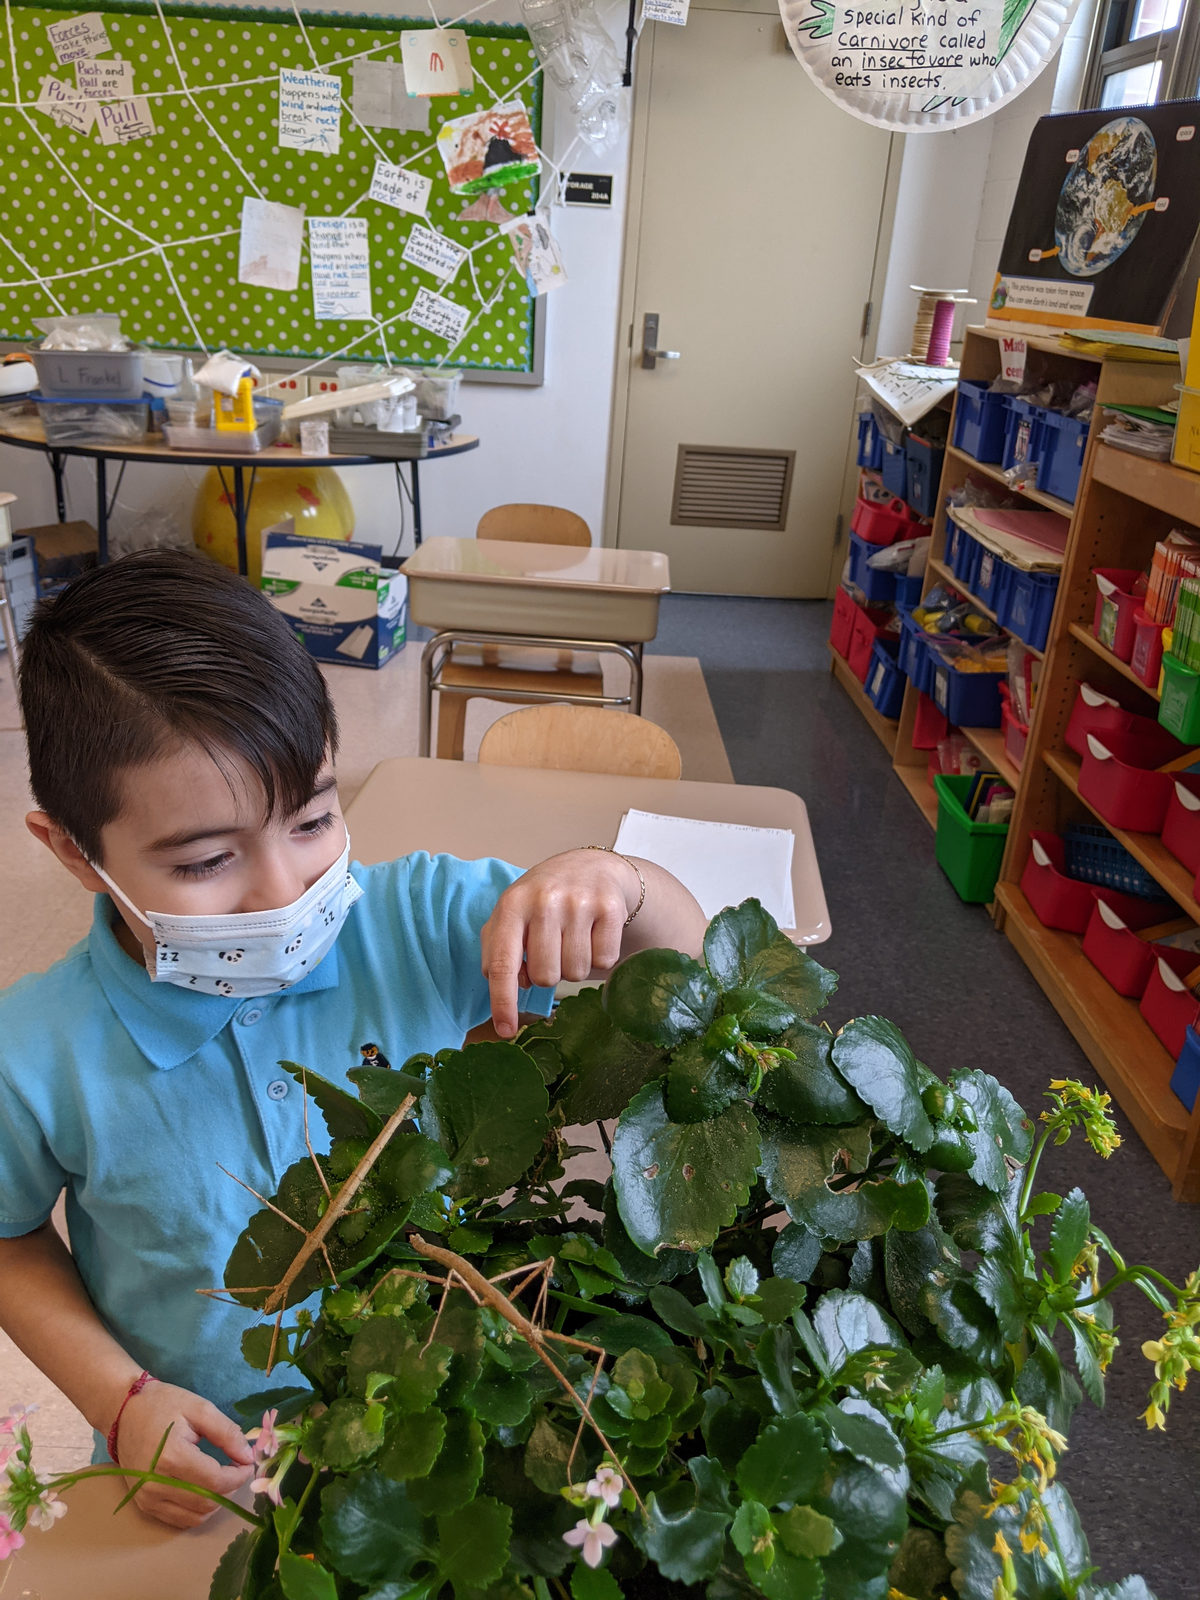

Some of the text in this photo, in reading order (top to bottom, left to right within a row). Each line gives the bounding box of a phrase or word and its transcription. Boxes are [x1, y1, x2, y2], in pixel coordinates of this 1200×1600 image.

[844, 5, 903, 30] special
[956, 9, 981, 27] of
[49, 22, 90, 43] Forces
[939, 31, 986, 49] called
[77, 60, 124, 76] Push and
[831, 55, 853, 67] an
[969, 53, 998, 67] who
[102, 80, 119, 88] are
[282, 71, 340, 97] Weathering
[835, 71, 946, 90] eats insects.
[281, 88, 320, 101] happens
[281, 100, 304, 110] wind
[306, 102, 320, 110] and
[100, 102, 138, 127] Pull
[281, 110, 338, 127] break rock
[280, 123, 306, 135] down
[377, 163, 425, 189] Earth is
[406, 190, 420, 202] of
[420, 289, 436, 304] The
[1019, 284, 1035, 293] picture
[1045, 286, 1057, 294] taken
[1048, 300, 1058, 308] land
[1058, 301, 1069, 309] and
[426, 304, 451, 322] Earth
[1002, 337, 1025, 353] Math
[58, 366, 70, 384] L
